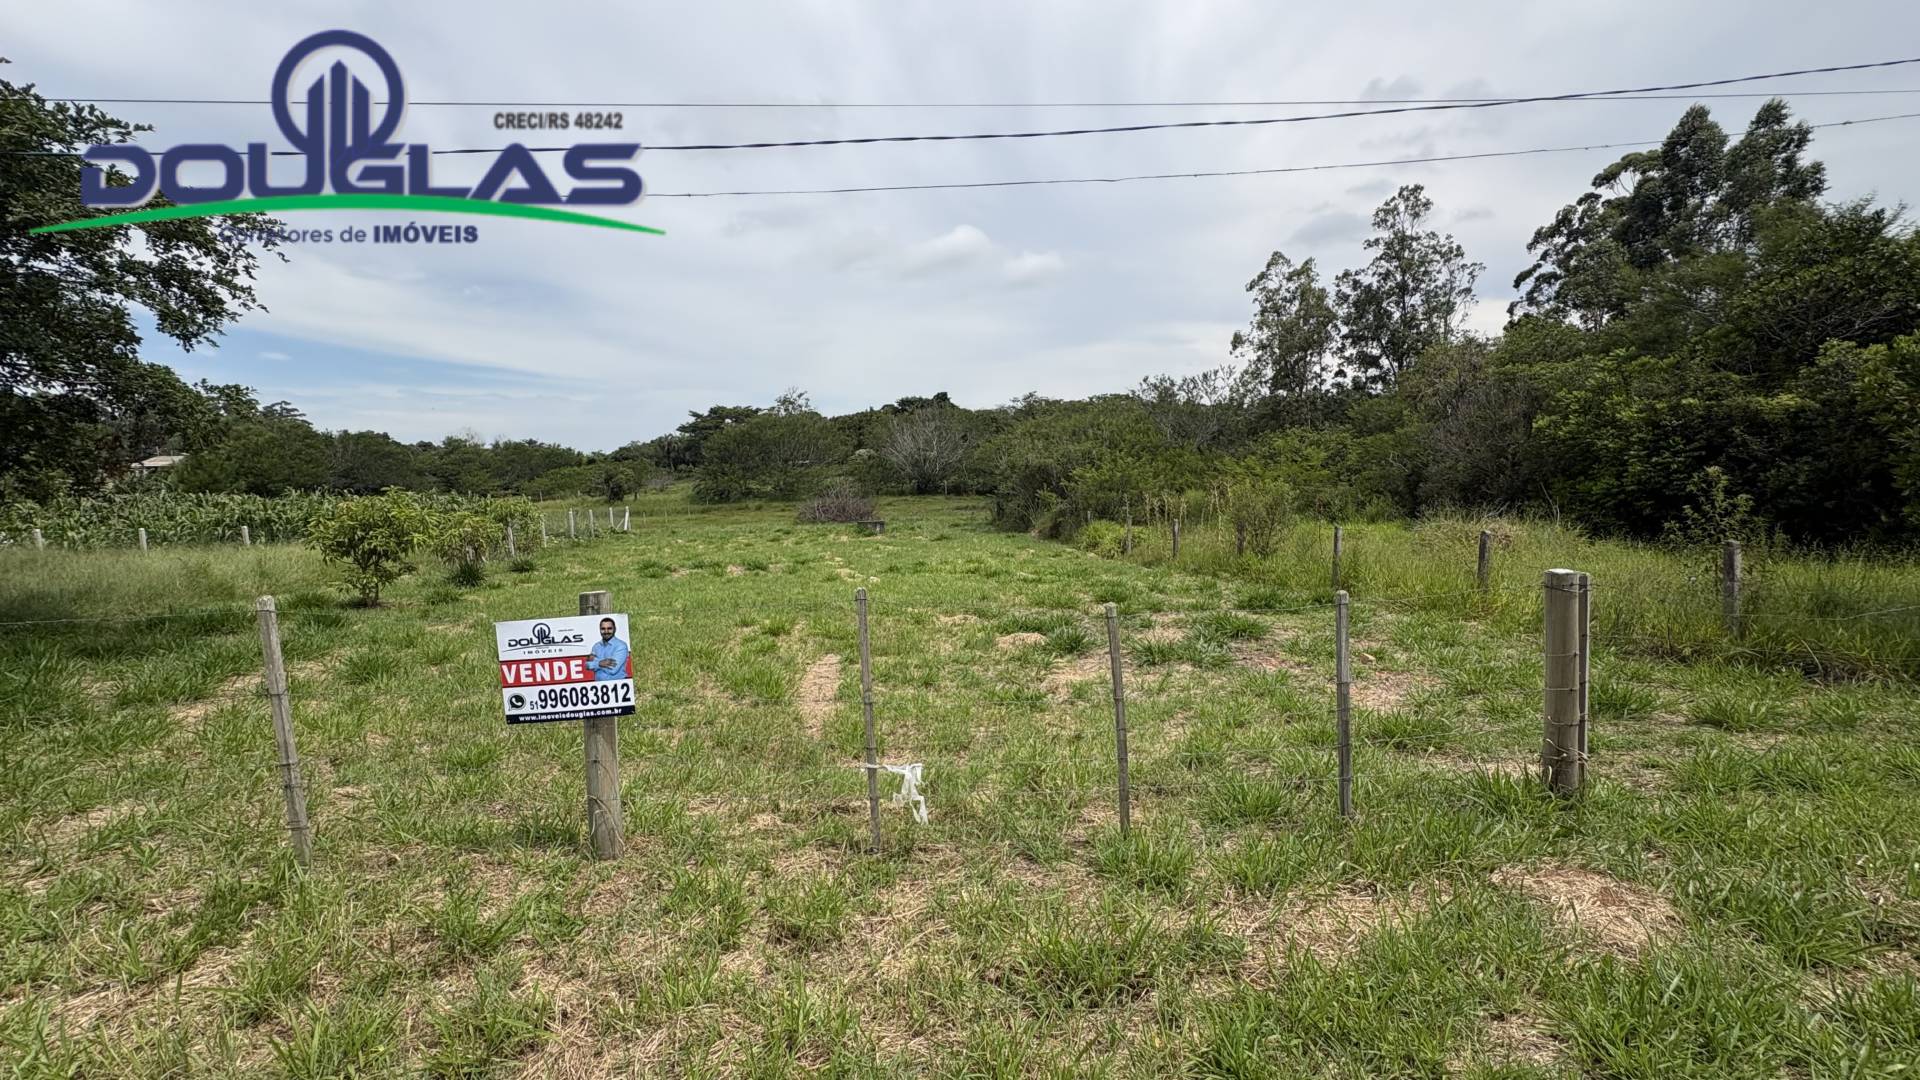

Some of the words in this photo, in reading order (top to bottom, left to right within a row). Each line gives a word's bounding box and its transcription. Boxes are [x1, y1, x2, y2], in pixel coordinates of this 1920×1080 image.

[508, 634, 584, 648] DOUGLAS
[502, 660, 584, 684] VENDE
[530, 700, 539, 710] 51
[538, 683, 631, 709] 996083812
[519, 709, 622, 721] www.imoveisdouglas.com.br
